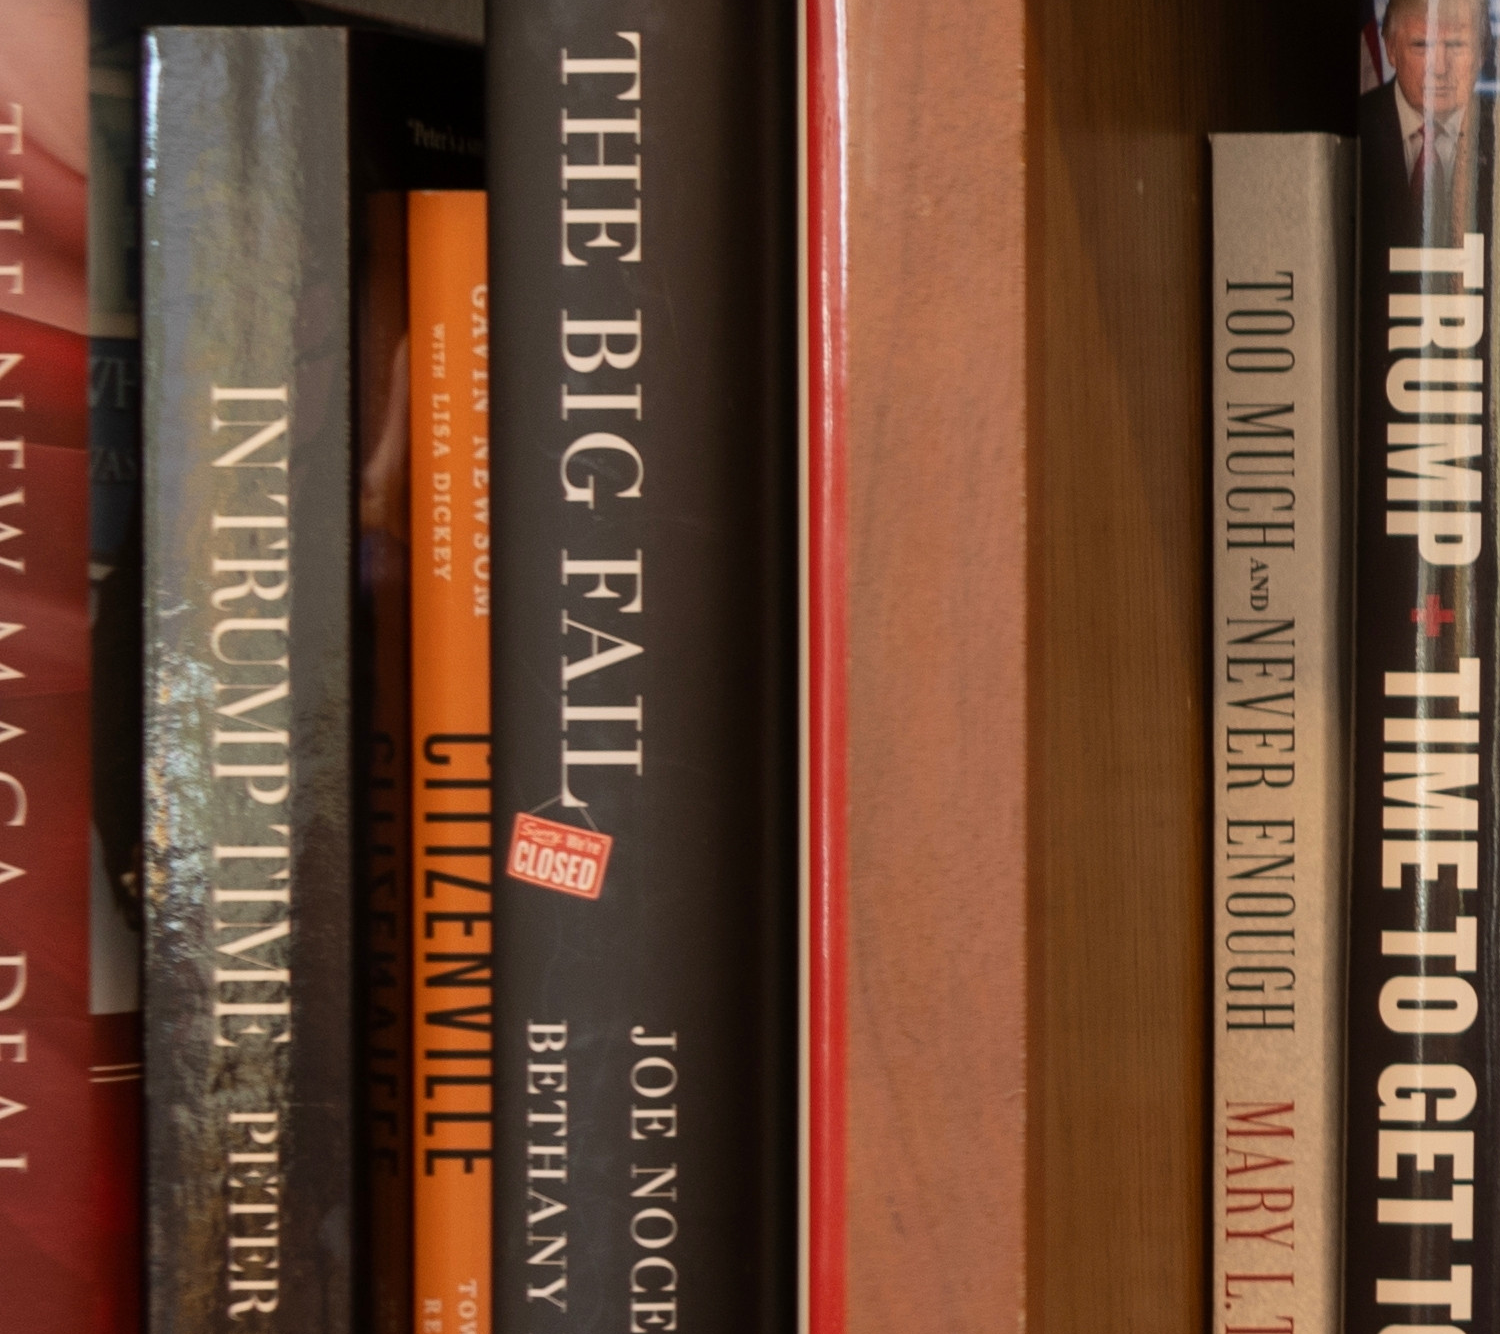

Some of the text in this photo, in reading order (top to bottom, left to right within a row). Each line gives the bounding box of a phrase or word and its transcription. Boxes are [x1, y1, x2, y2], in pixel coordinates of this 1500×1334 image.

[431, 322, 453, 583] WITH LISA DICKEY
[471, 282, 491, 618] GAVIN NEWSOM
[559, 30, 646, 808] THE BIG FAIL
[1384, 232, 1484, 568] TRUMP
[210, 382, 293, 1050] IN TRUMP TIME
[1223, 270, 1297, 1035] TOO MUCH AND NEVER ENOUGH
[1380, 657, 1482, 891] TIME
[513, 839, 598, 892] CLOSED
[1377, 916, 1480, 1036] TO
[525, 1019, 569, 1312] BETHANY
[629, 1024, 680, 1142] JOE
[1224, 1099, 1296, 1252] MARY
[1376, 1063, 1479, 1241] GET
[226, 1108, 284, 1324] PETER
